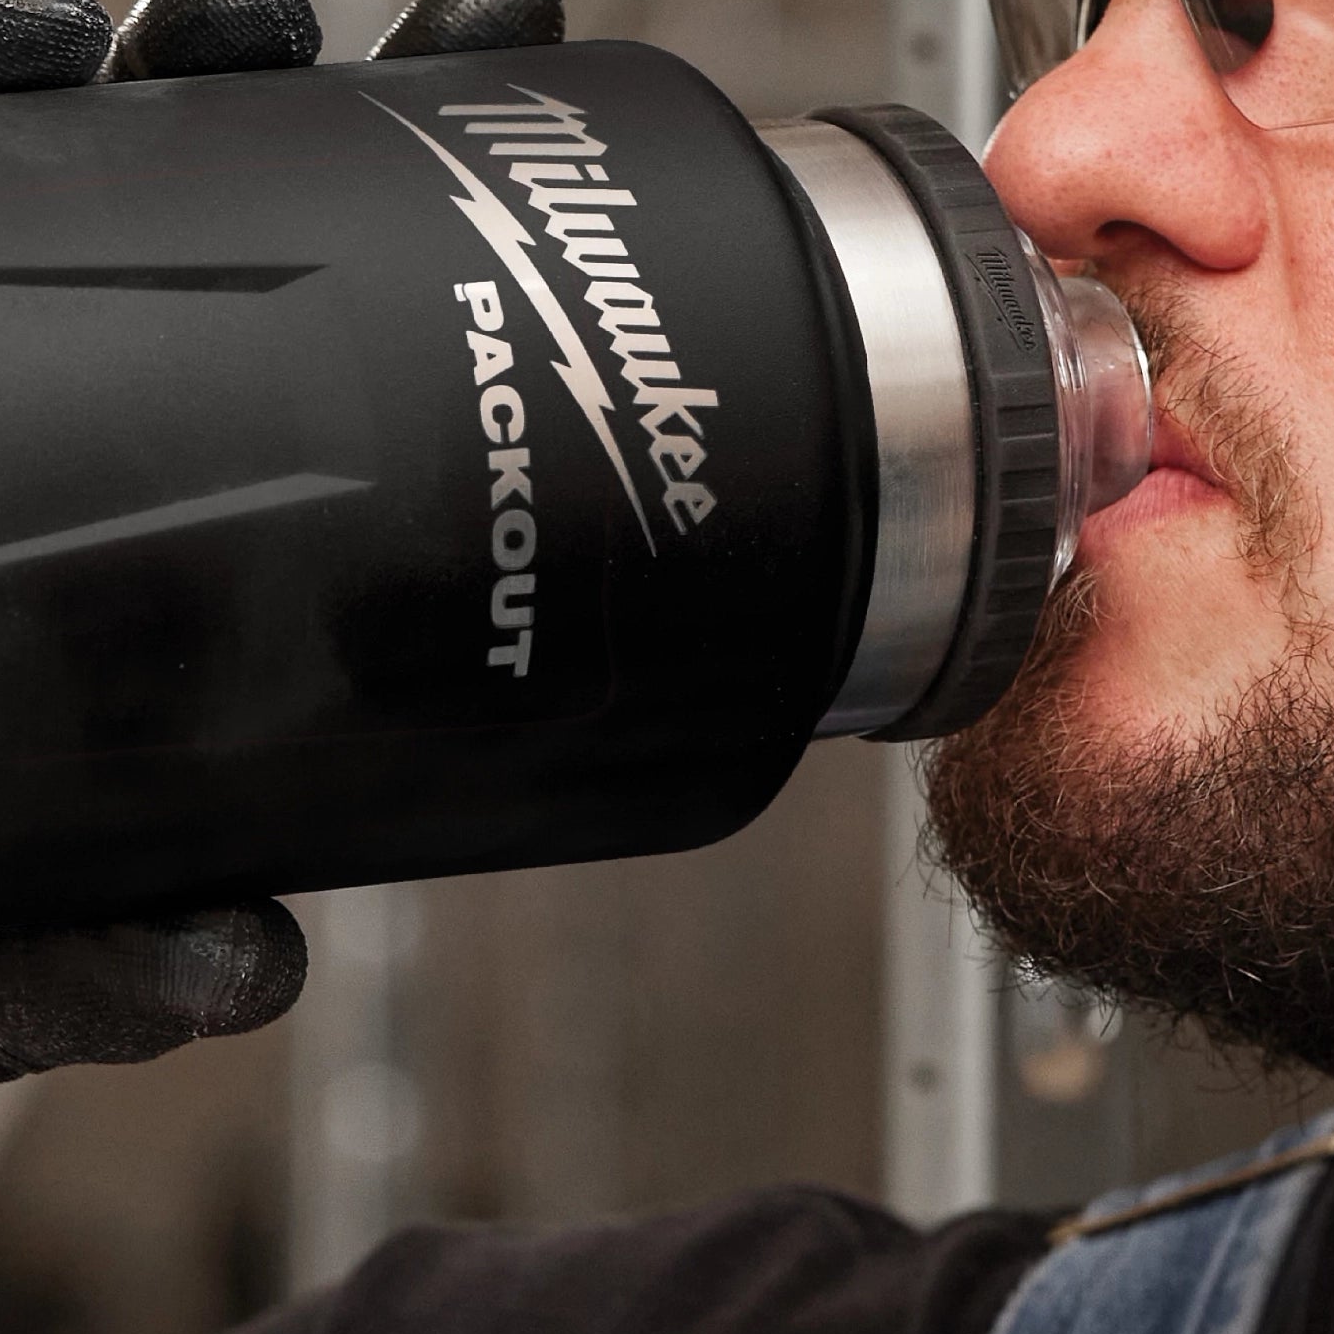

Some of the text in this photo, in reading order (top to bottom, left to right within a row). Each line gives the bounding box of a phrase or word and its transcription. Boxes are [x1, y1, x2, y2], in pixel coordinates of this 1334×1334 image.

[438, 83, 720, 536] Milwaukee
[454, 280, 538, 677] PACKOUT
[976, 247, 1037, 350] Milwaukee
